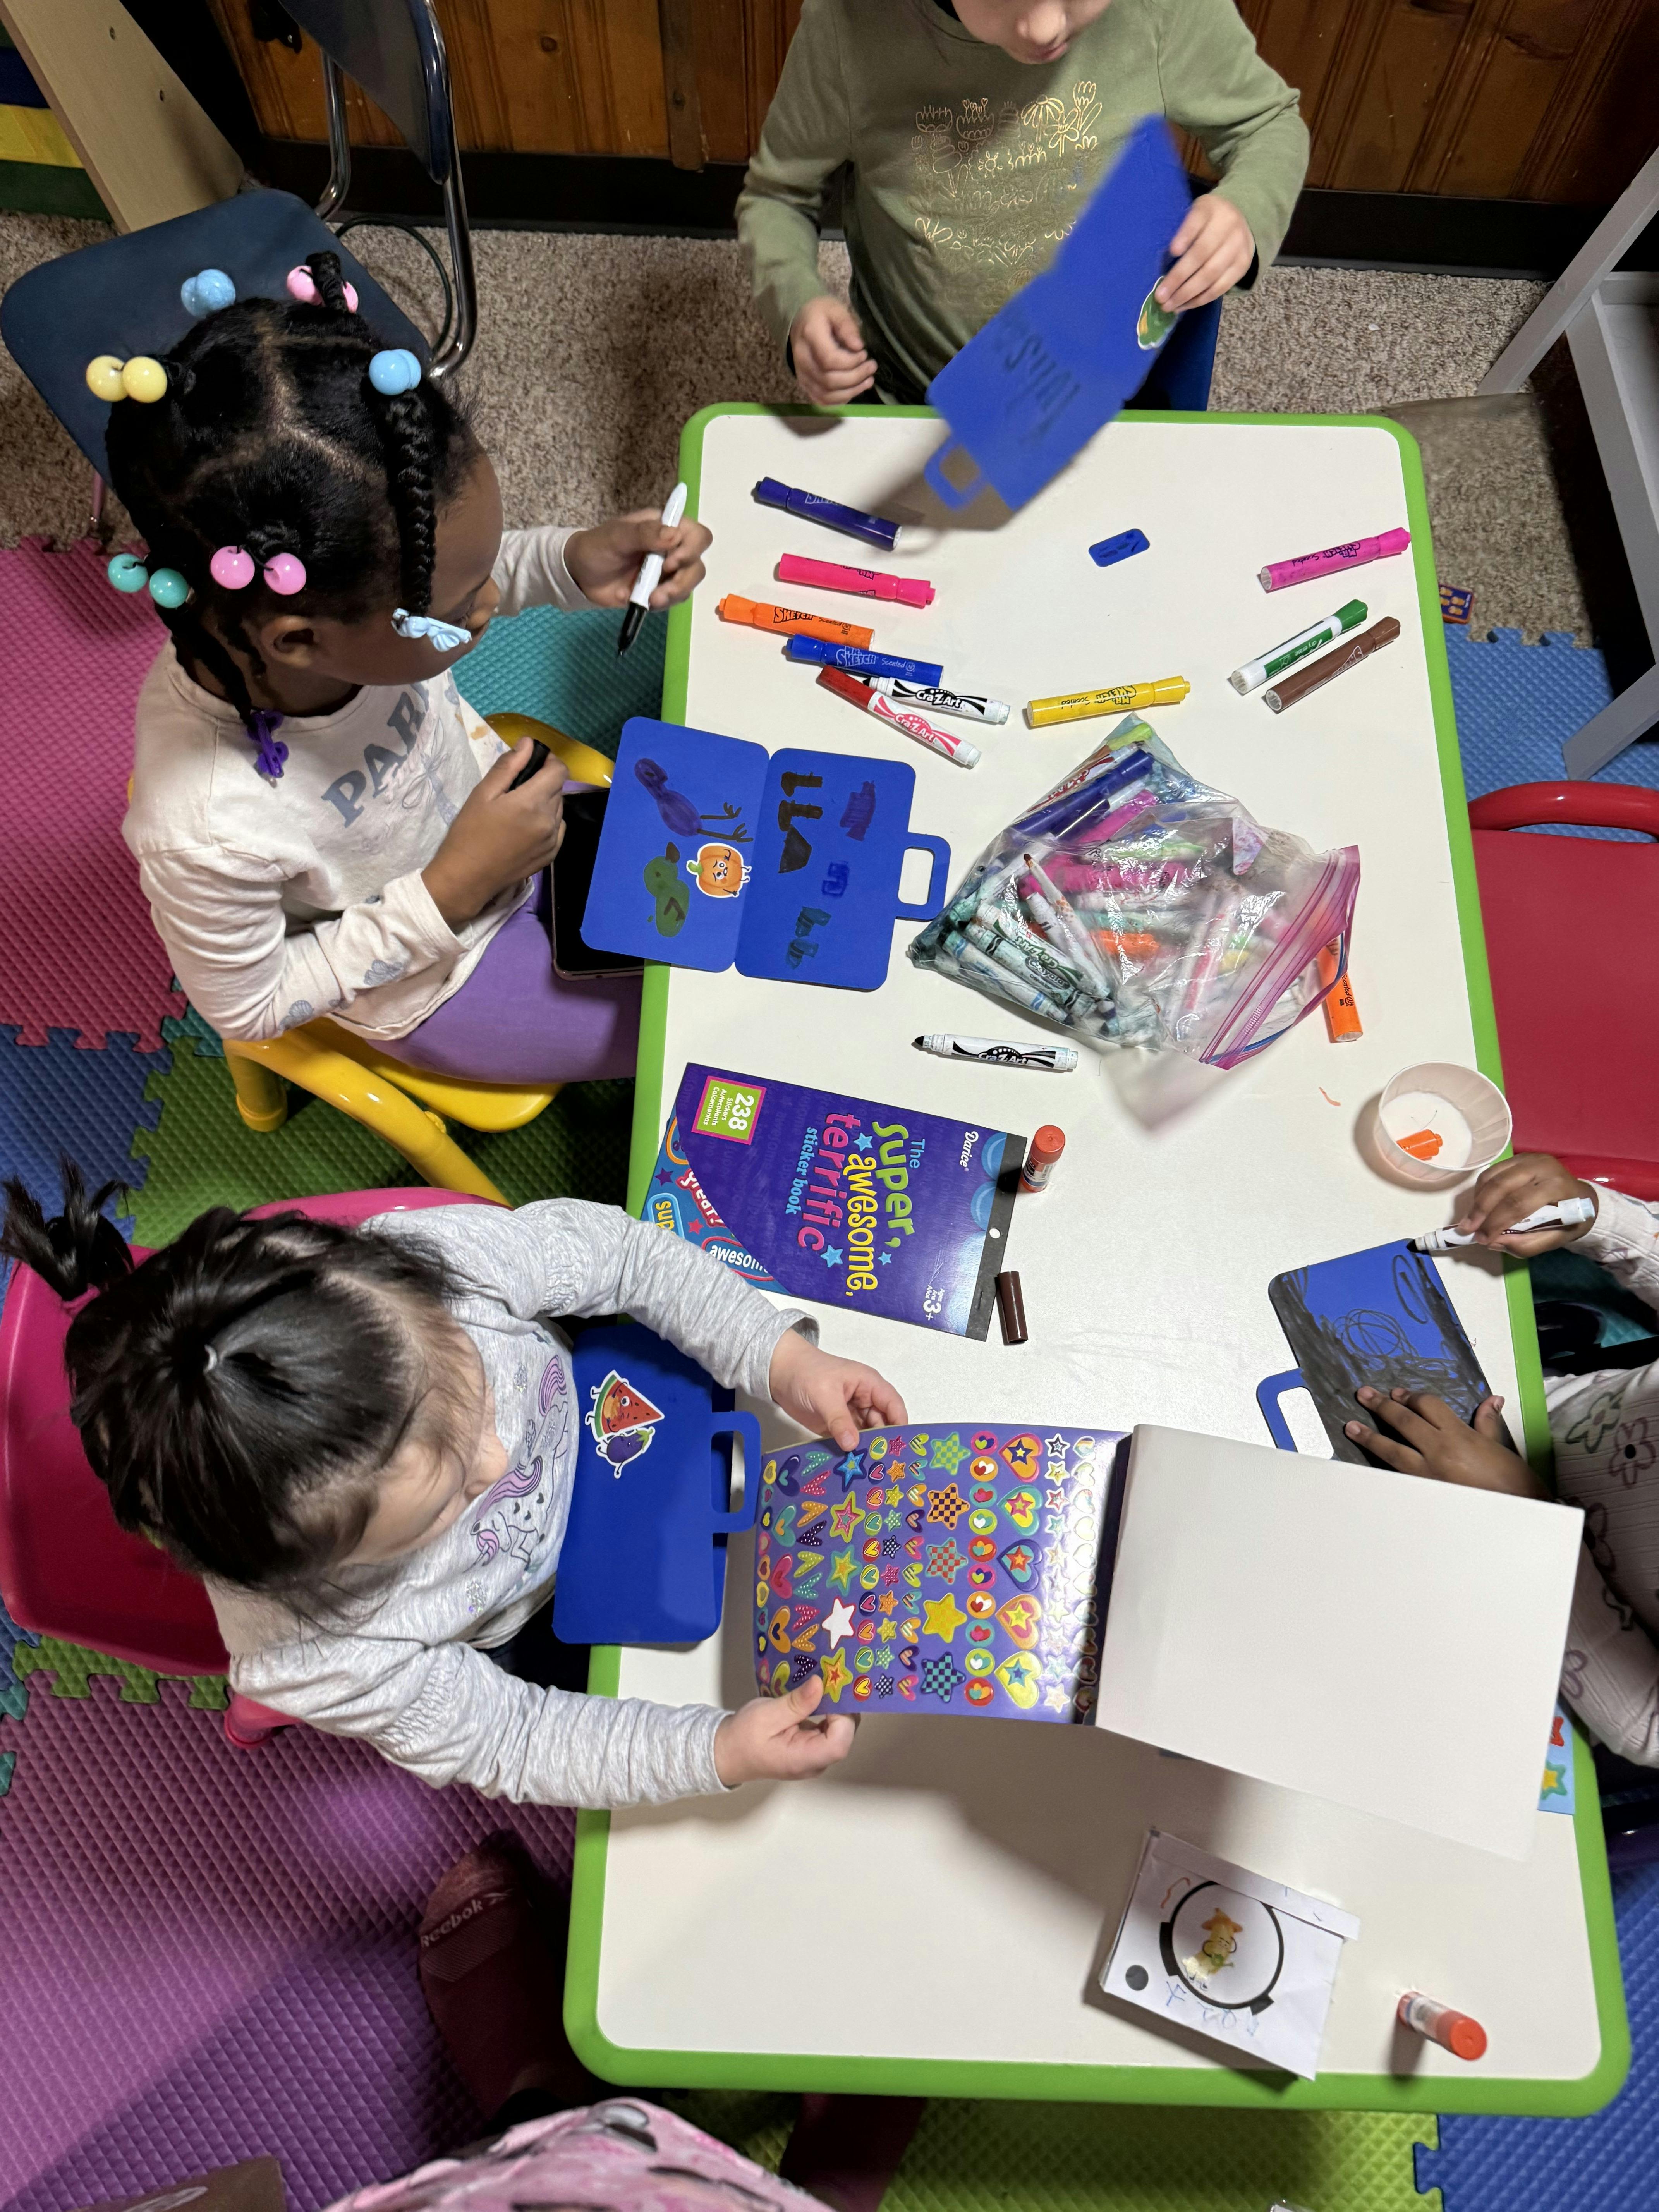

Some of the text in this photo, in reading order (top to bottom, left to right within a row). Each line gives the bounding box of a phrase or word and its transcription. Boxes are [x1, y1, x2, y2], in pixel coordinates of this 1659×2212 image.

[773, 606, 813, 623] SKETCH
[836, 649, 877, 666] SKETCH
[881, 658, 905, 668] Scented
[1061, 685, 1137, 709] SKETCH Scented
[1113, 695, 1131, 705] MR.
[711, 1089, 728, 1126] Autocollants
[721, 1097, 733, 1121] Stickers
[728, 1092, 754, 1130] 238
[909, 1138, 926, 1169] The
[785, 1127, 817, 1215] sticker book
[798, 1113, 861, 1251] terrific
[872, 1121, 915, 1248] Super,
[655, 1201, 676, 1236] sup
[843, 1154, 878, 1296] awesome,
[709, 1245, 769, 1273] awesom
[923, 1300, 941, 1321] 3+
[421, 1899, 483, 1947] Reebok
